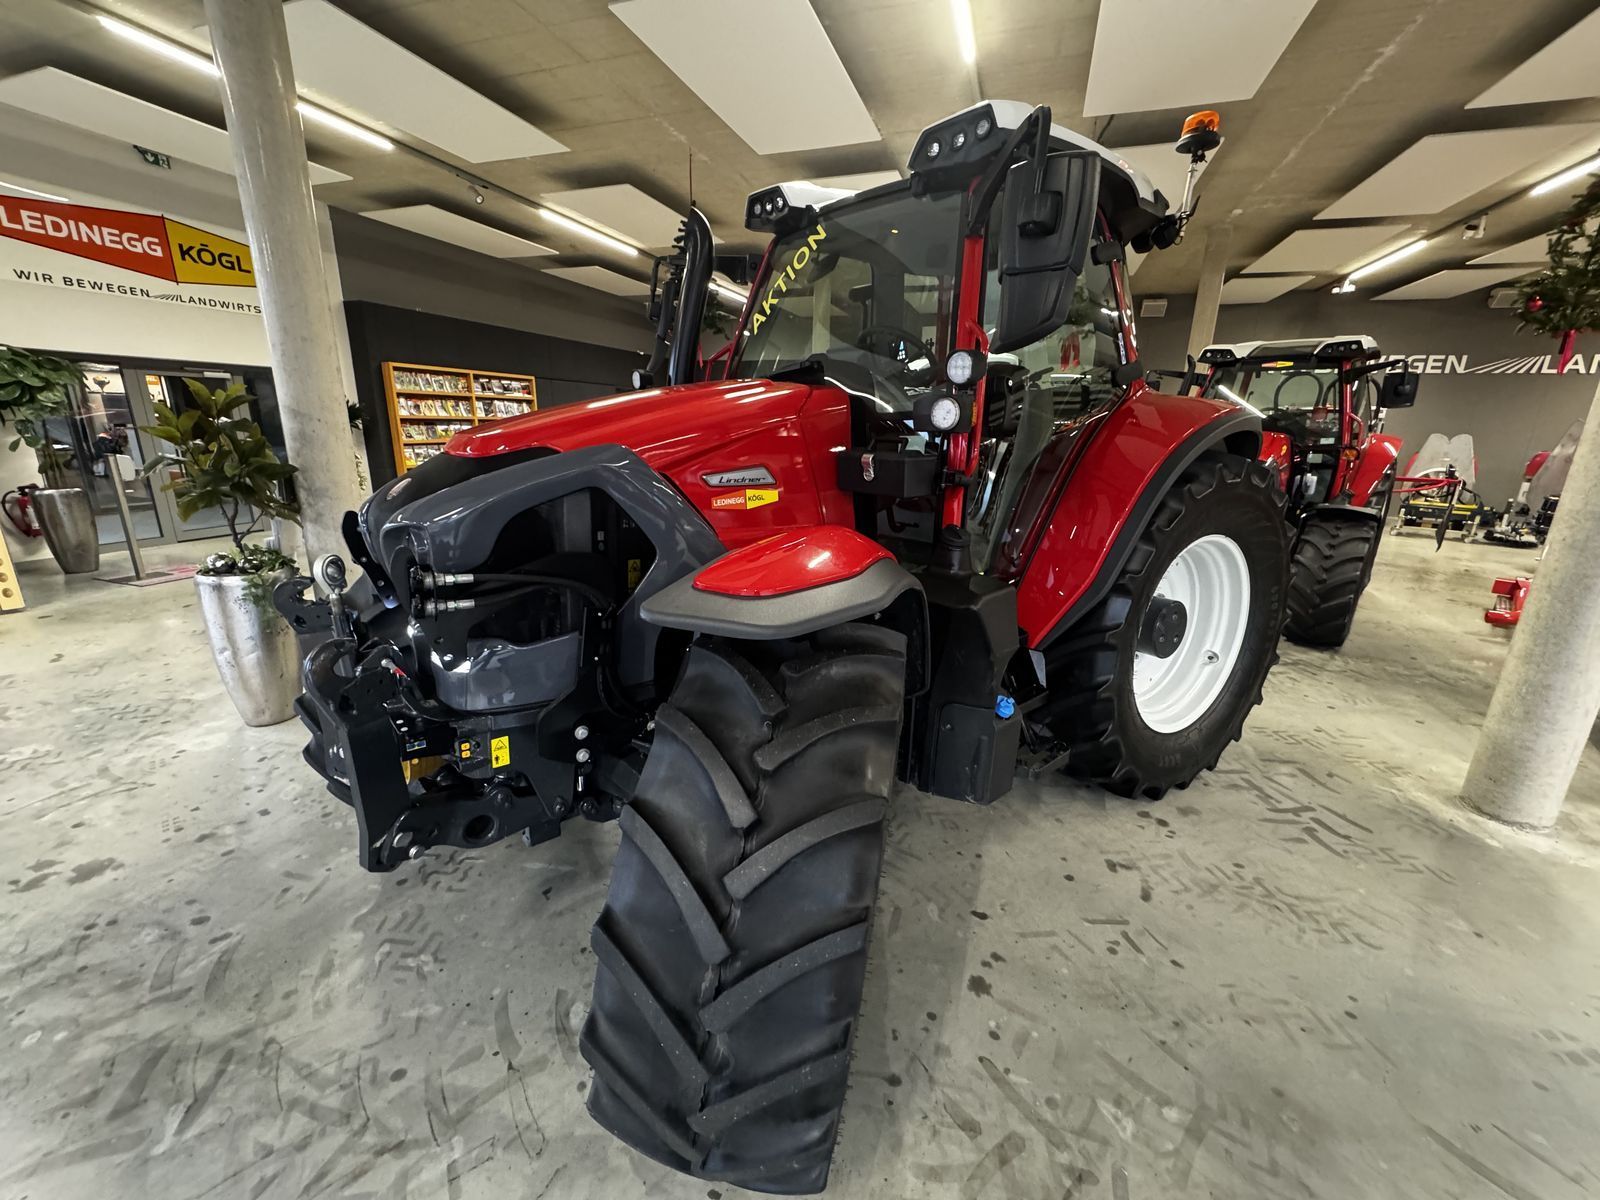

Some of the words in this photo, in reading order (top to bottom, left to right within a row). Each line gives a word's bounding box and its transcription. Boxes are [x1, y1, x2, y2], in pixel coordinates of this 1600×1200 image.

[0, 204, 164, 257] LEDINEGG
[13, 268, 54, 284] WIR
[63, 276, 151, 298] BEWEGEN
[752, 223, 827, 336] AKTION
[718, 475, 766, 484] Lindner
[713, 496, 745, 507] LEDINEGG
